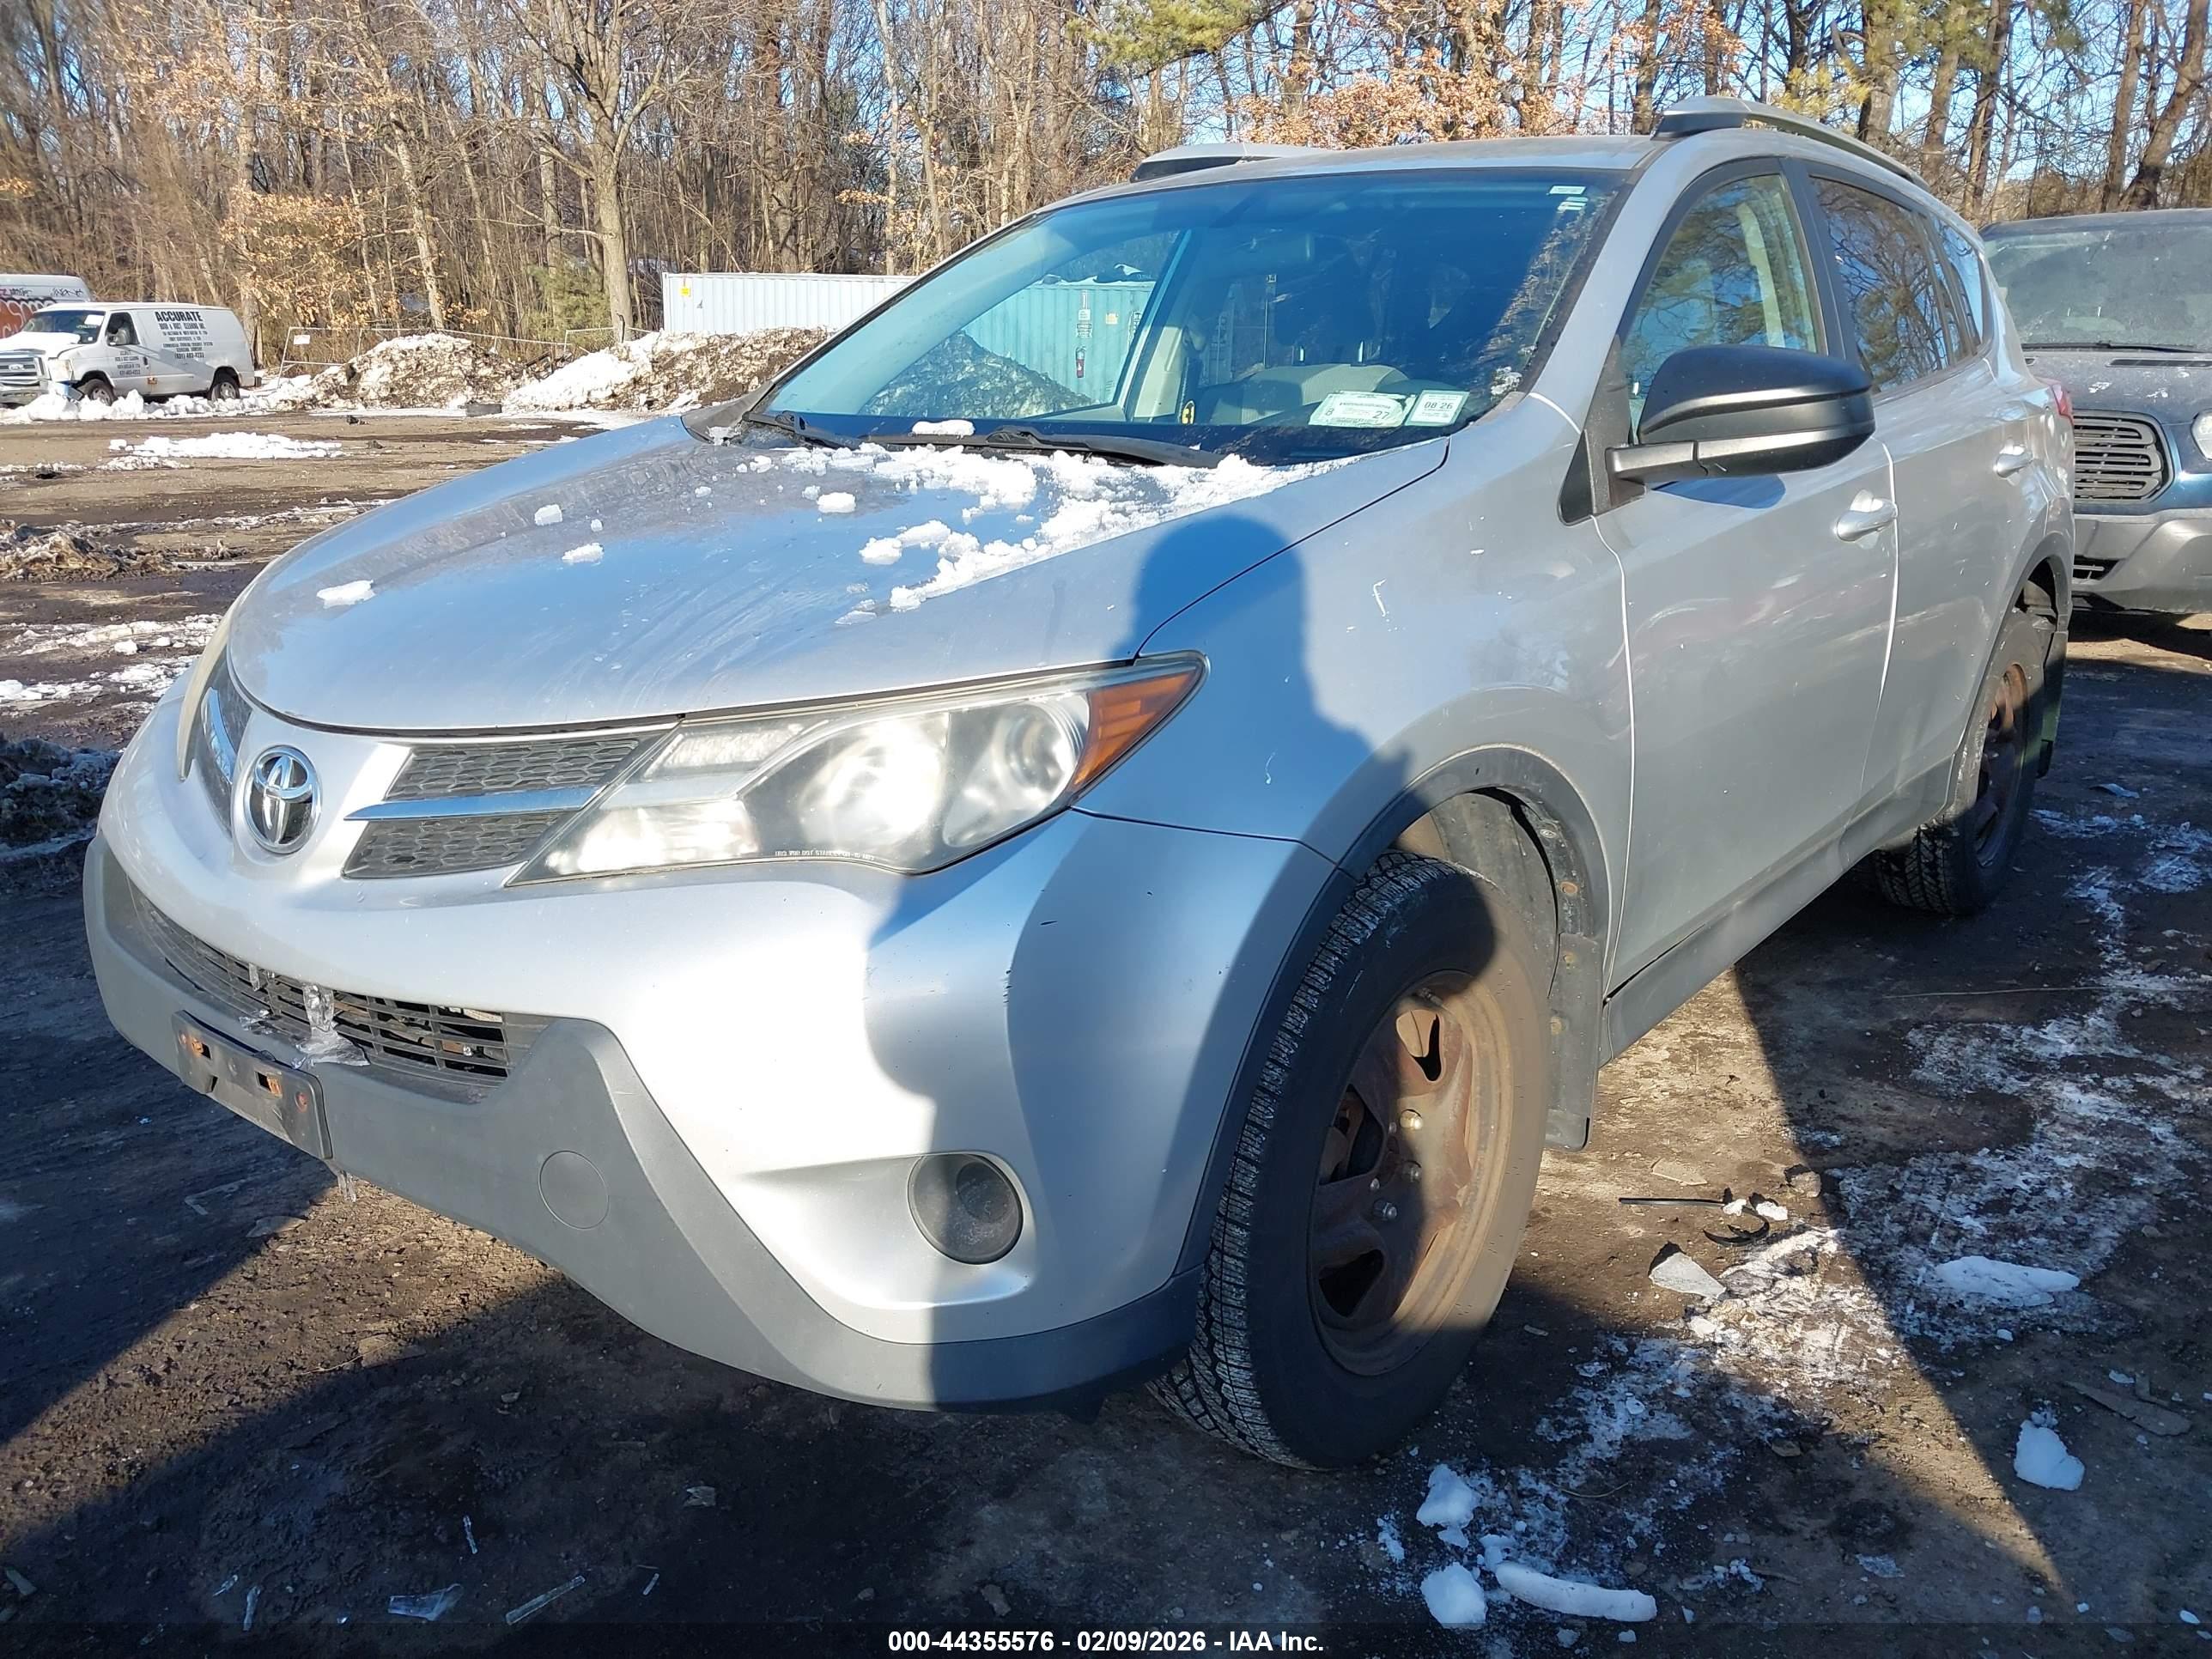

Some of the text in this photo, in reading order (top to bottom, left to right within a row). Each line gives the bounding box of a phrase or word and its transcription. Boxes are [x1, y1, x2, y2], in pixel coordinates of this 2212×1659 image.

[155, 311, 204, 322] ACCURATE
[1439, 402, 1454, 410] 26
[1372, 410, 1390, 421] 27
